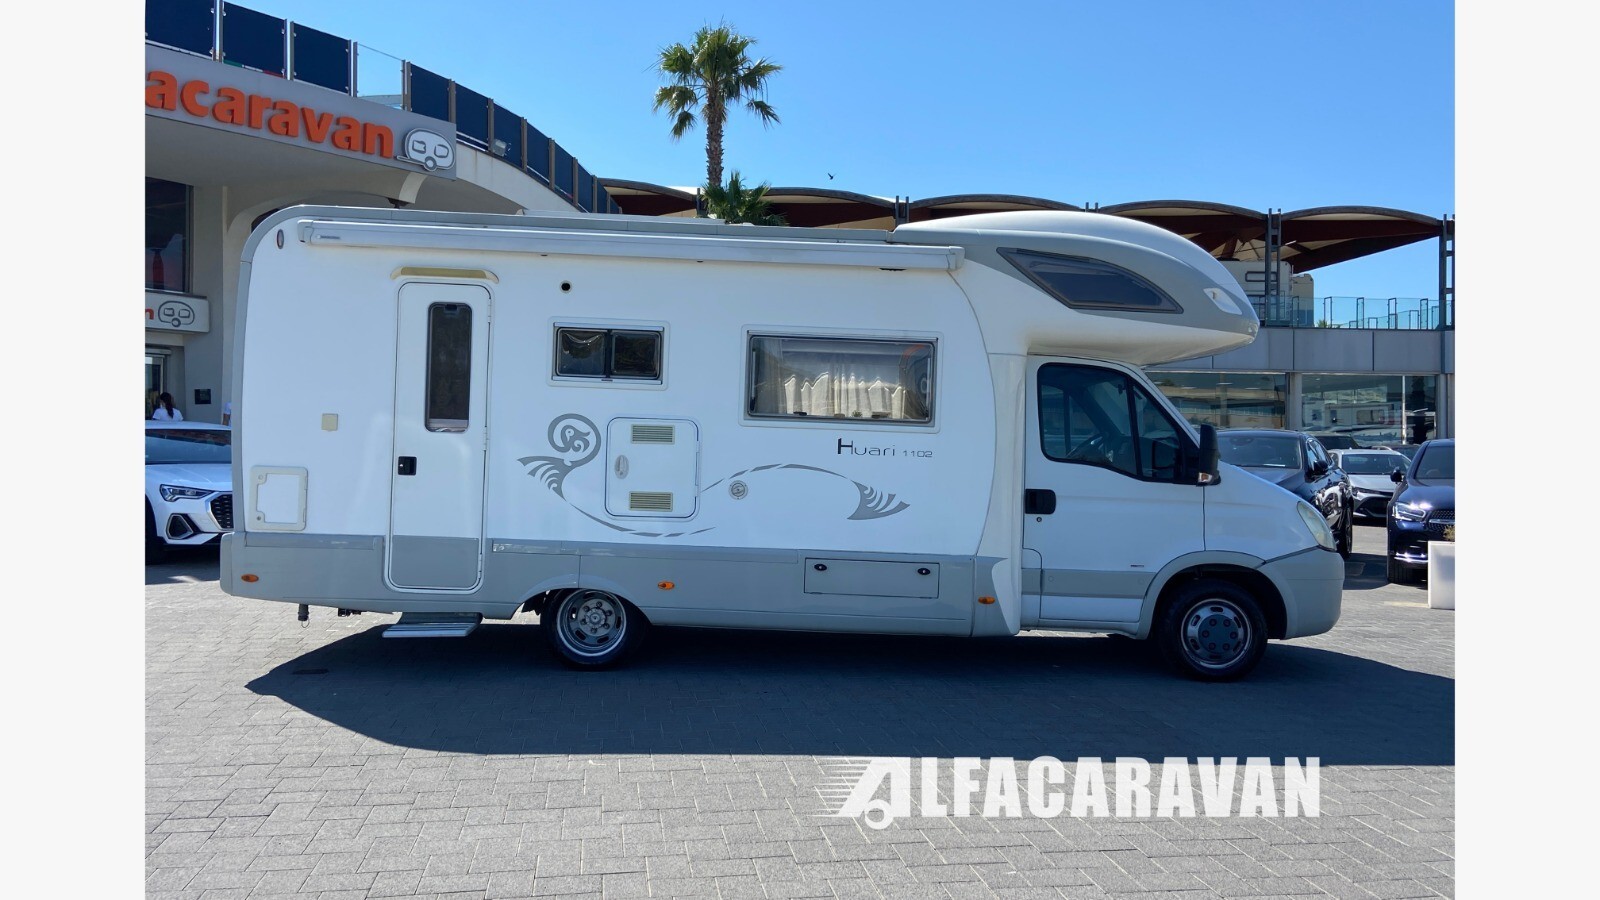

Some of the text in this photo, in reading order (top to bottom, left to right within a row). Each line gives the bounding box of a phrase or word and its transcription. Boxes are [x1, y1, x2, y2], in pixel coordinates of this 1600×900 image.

[145, 71, 394, 159] acaravan
[837, 438, 933, 458] Huari 1102
